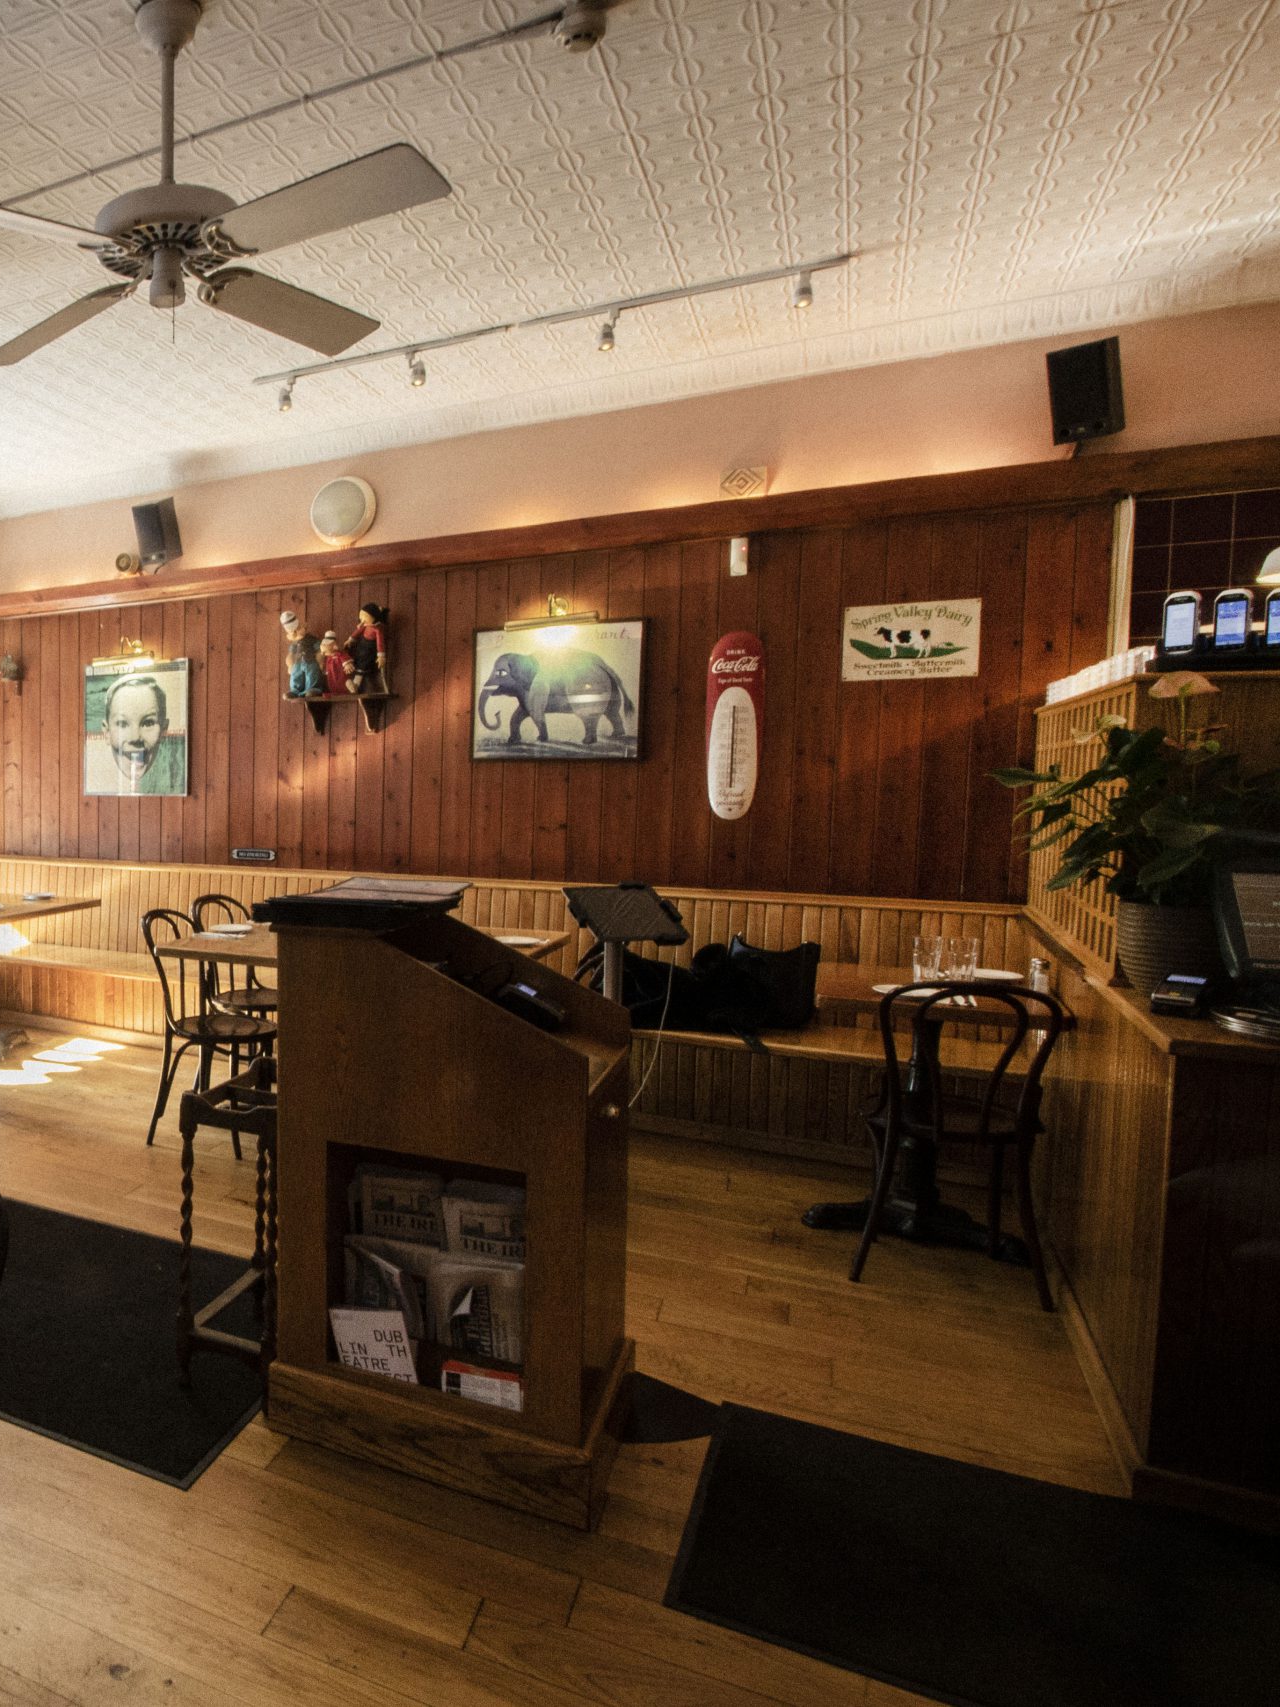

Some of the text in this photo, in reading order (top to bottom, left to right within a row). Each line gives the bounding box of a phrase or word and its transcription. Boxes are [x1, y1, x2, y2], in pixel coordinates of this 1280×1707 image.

[851, 605, 973, 629] Spring Valley Dairy
[712, 656, 760, 674] Coca-Cola
[853, 658, 966, 670] Sweetmilk Buttermilk
[867, 666, 954, 676] Creamery Butter
[460, 1236, 498, 1255] THE
[373, 1329, 404, 1343] DUB
[339, 1342, 408, 1358] LIN TH
[343, 1355, 391, 1371] EATRE
